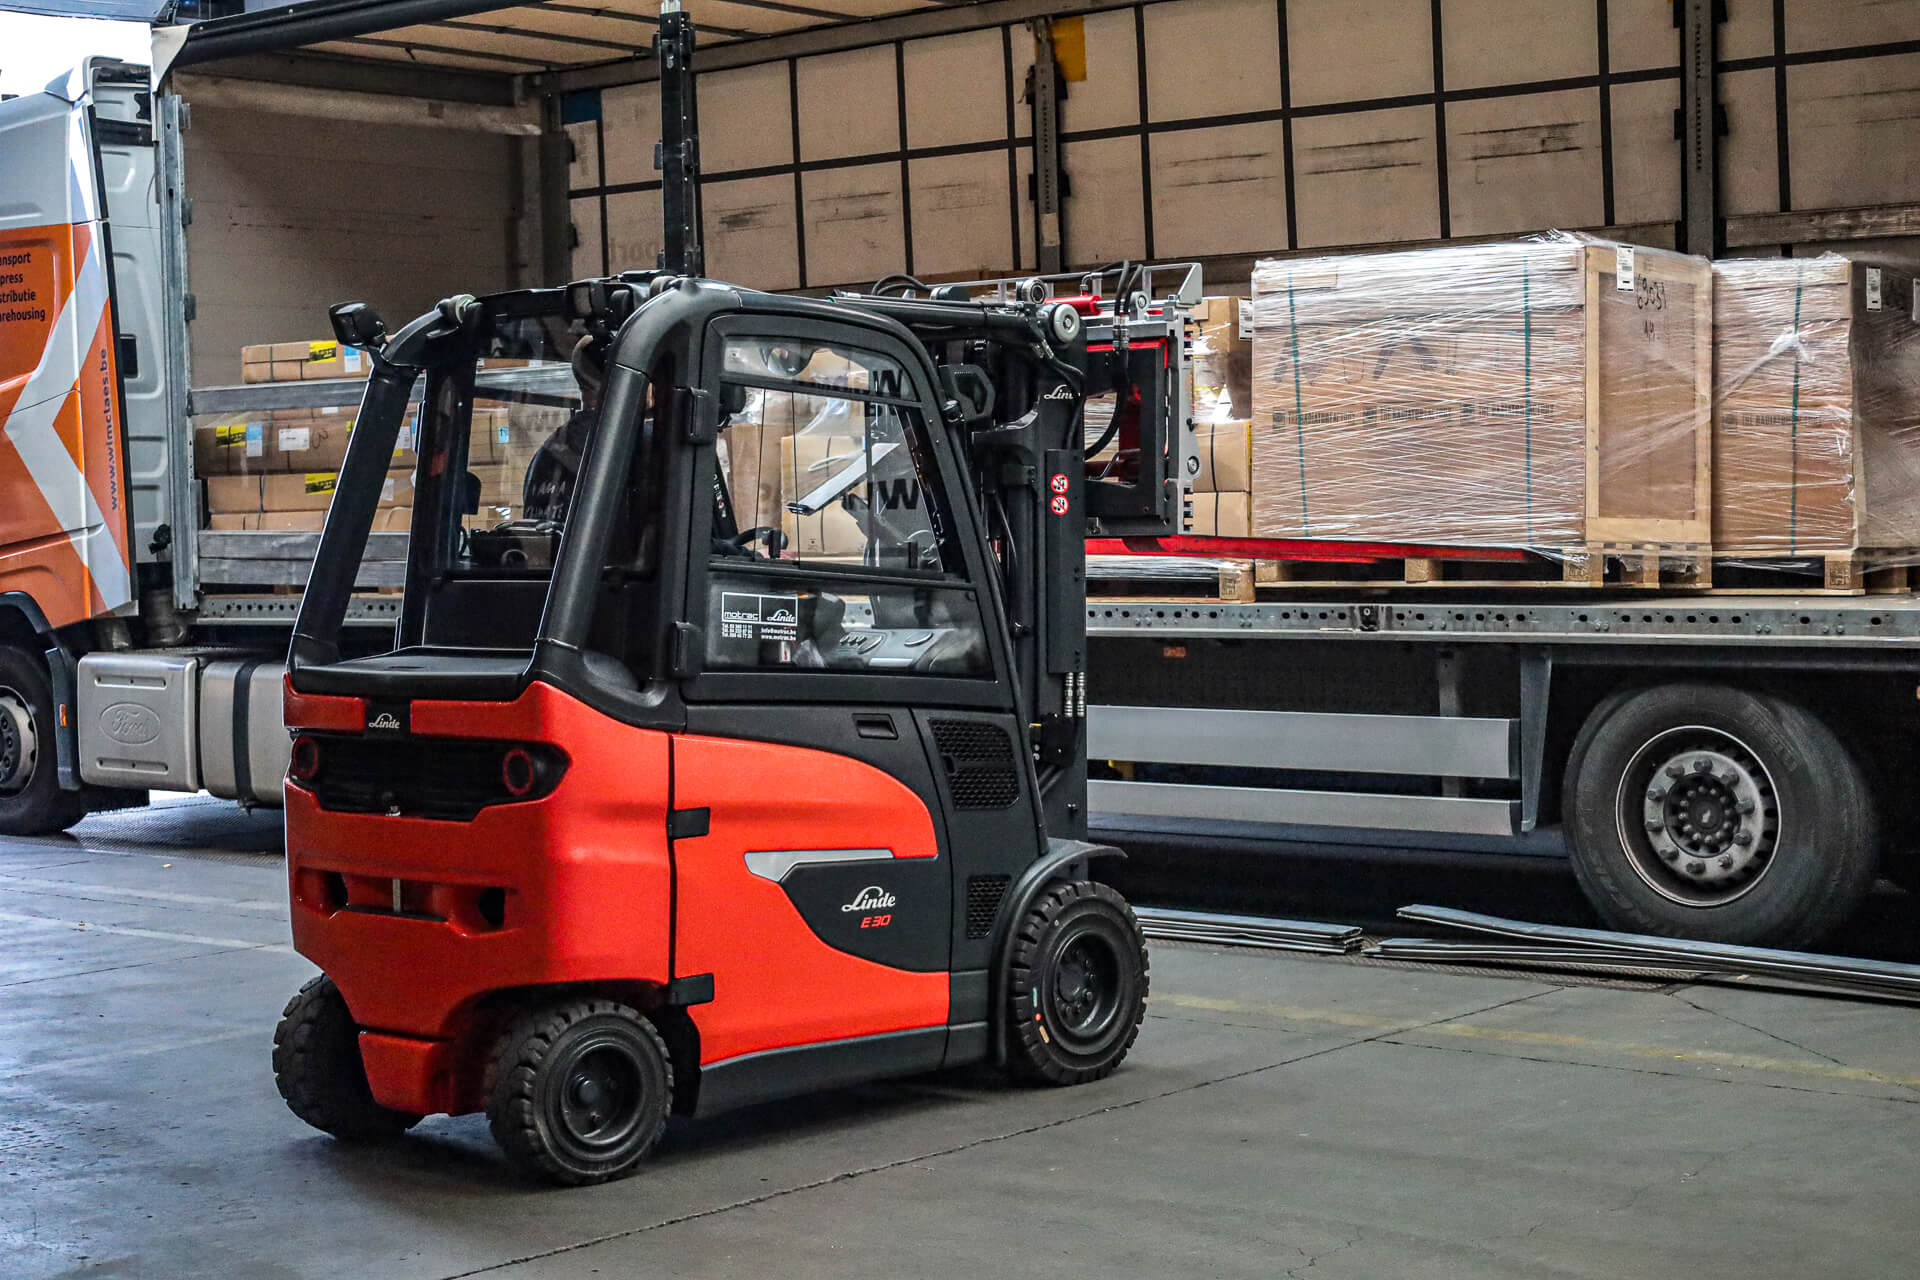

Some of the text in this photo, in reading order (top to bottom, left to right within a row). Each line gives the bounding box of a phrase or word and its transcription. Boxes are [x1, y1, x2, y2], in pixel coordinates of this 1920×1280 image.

[1043, 384, 1081, 400] Lin
[100, 348, 118, 511] www.wimclaes.be
[724, 608, 796, 622] motrac Linde
[111, 709, 151, 737] Ford
[368, 712, 401, 729] Linde
[841, 885, 896, 912] Linde
